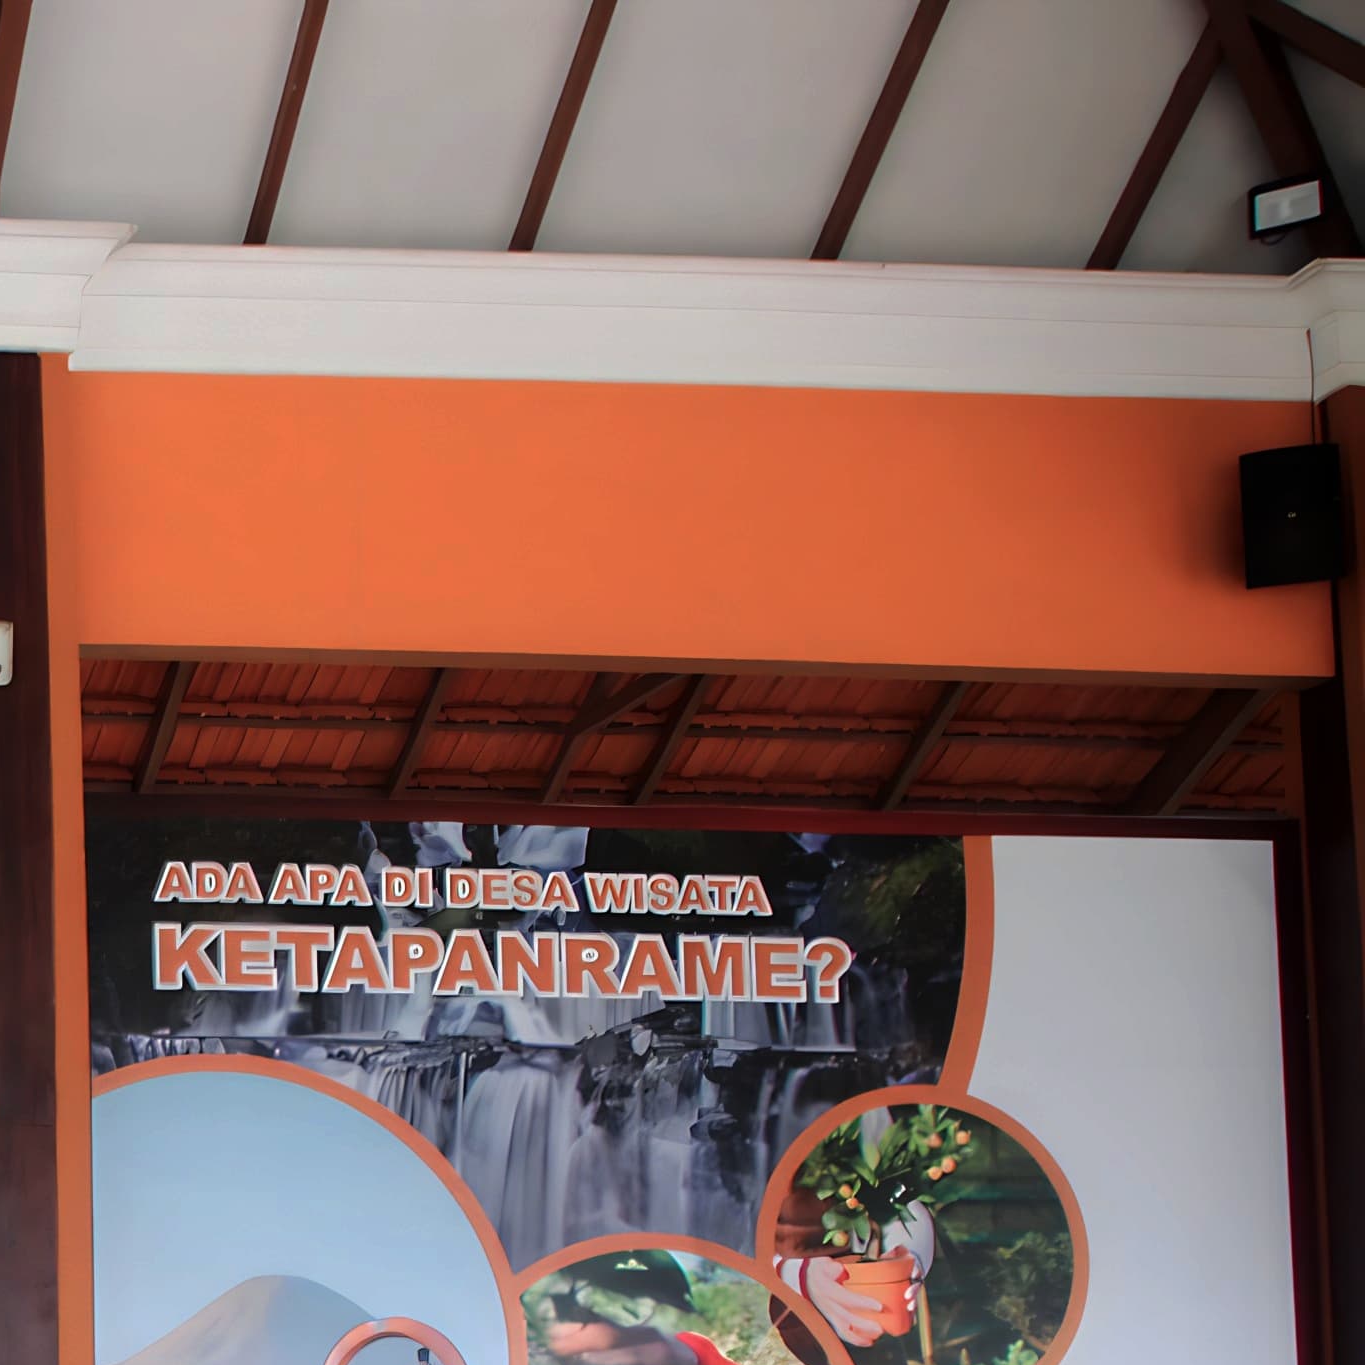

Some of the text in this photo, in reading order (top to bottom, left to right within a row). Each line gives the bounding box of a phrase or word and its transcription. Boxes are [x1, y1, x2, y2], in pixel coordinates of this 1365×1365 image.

[154, 861, 773, 917] ADA APA DI DESA WISATA
[153, 921, 852, 1004] KETAPANRAME?
